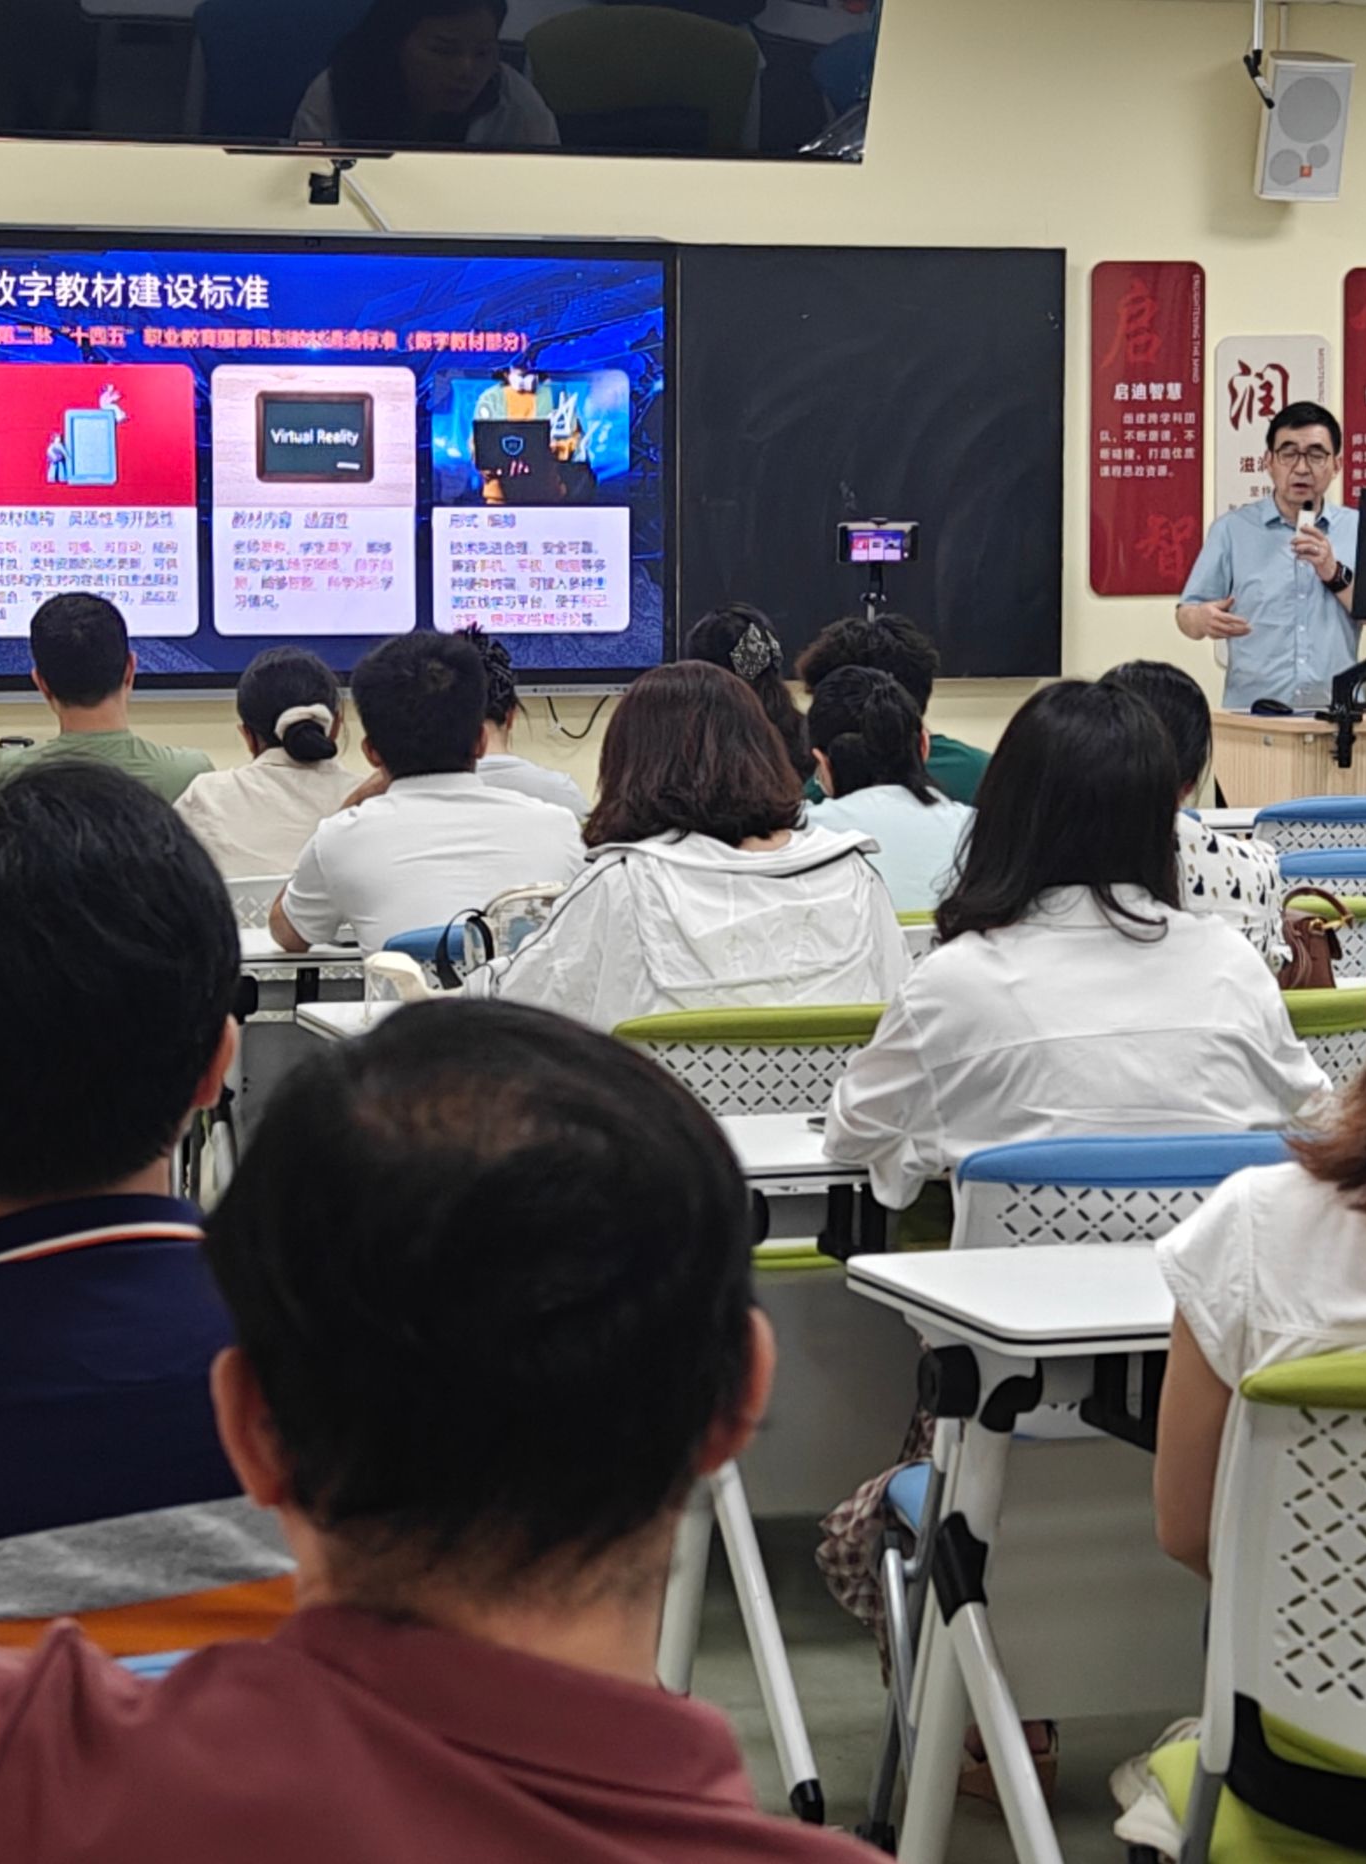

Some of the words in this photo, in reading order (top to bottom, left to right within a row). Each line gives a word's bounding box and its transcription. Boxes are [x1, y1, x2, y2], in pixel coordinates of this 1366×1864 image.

[1113, 382, 1183, 402] 启迪智慧
[1229, 359, 1290, 431] 润
[270, 427, 314, 447] Virtual
[317, 427, 360, 449] Reality
